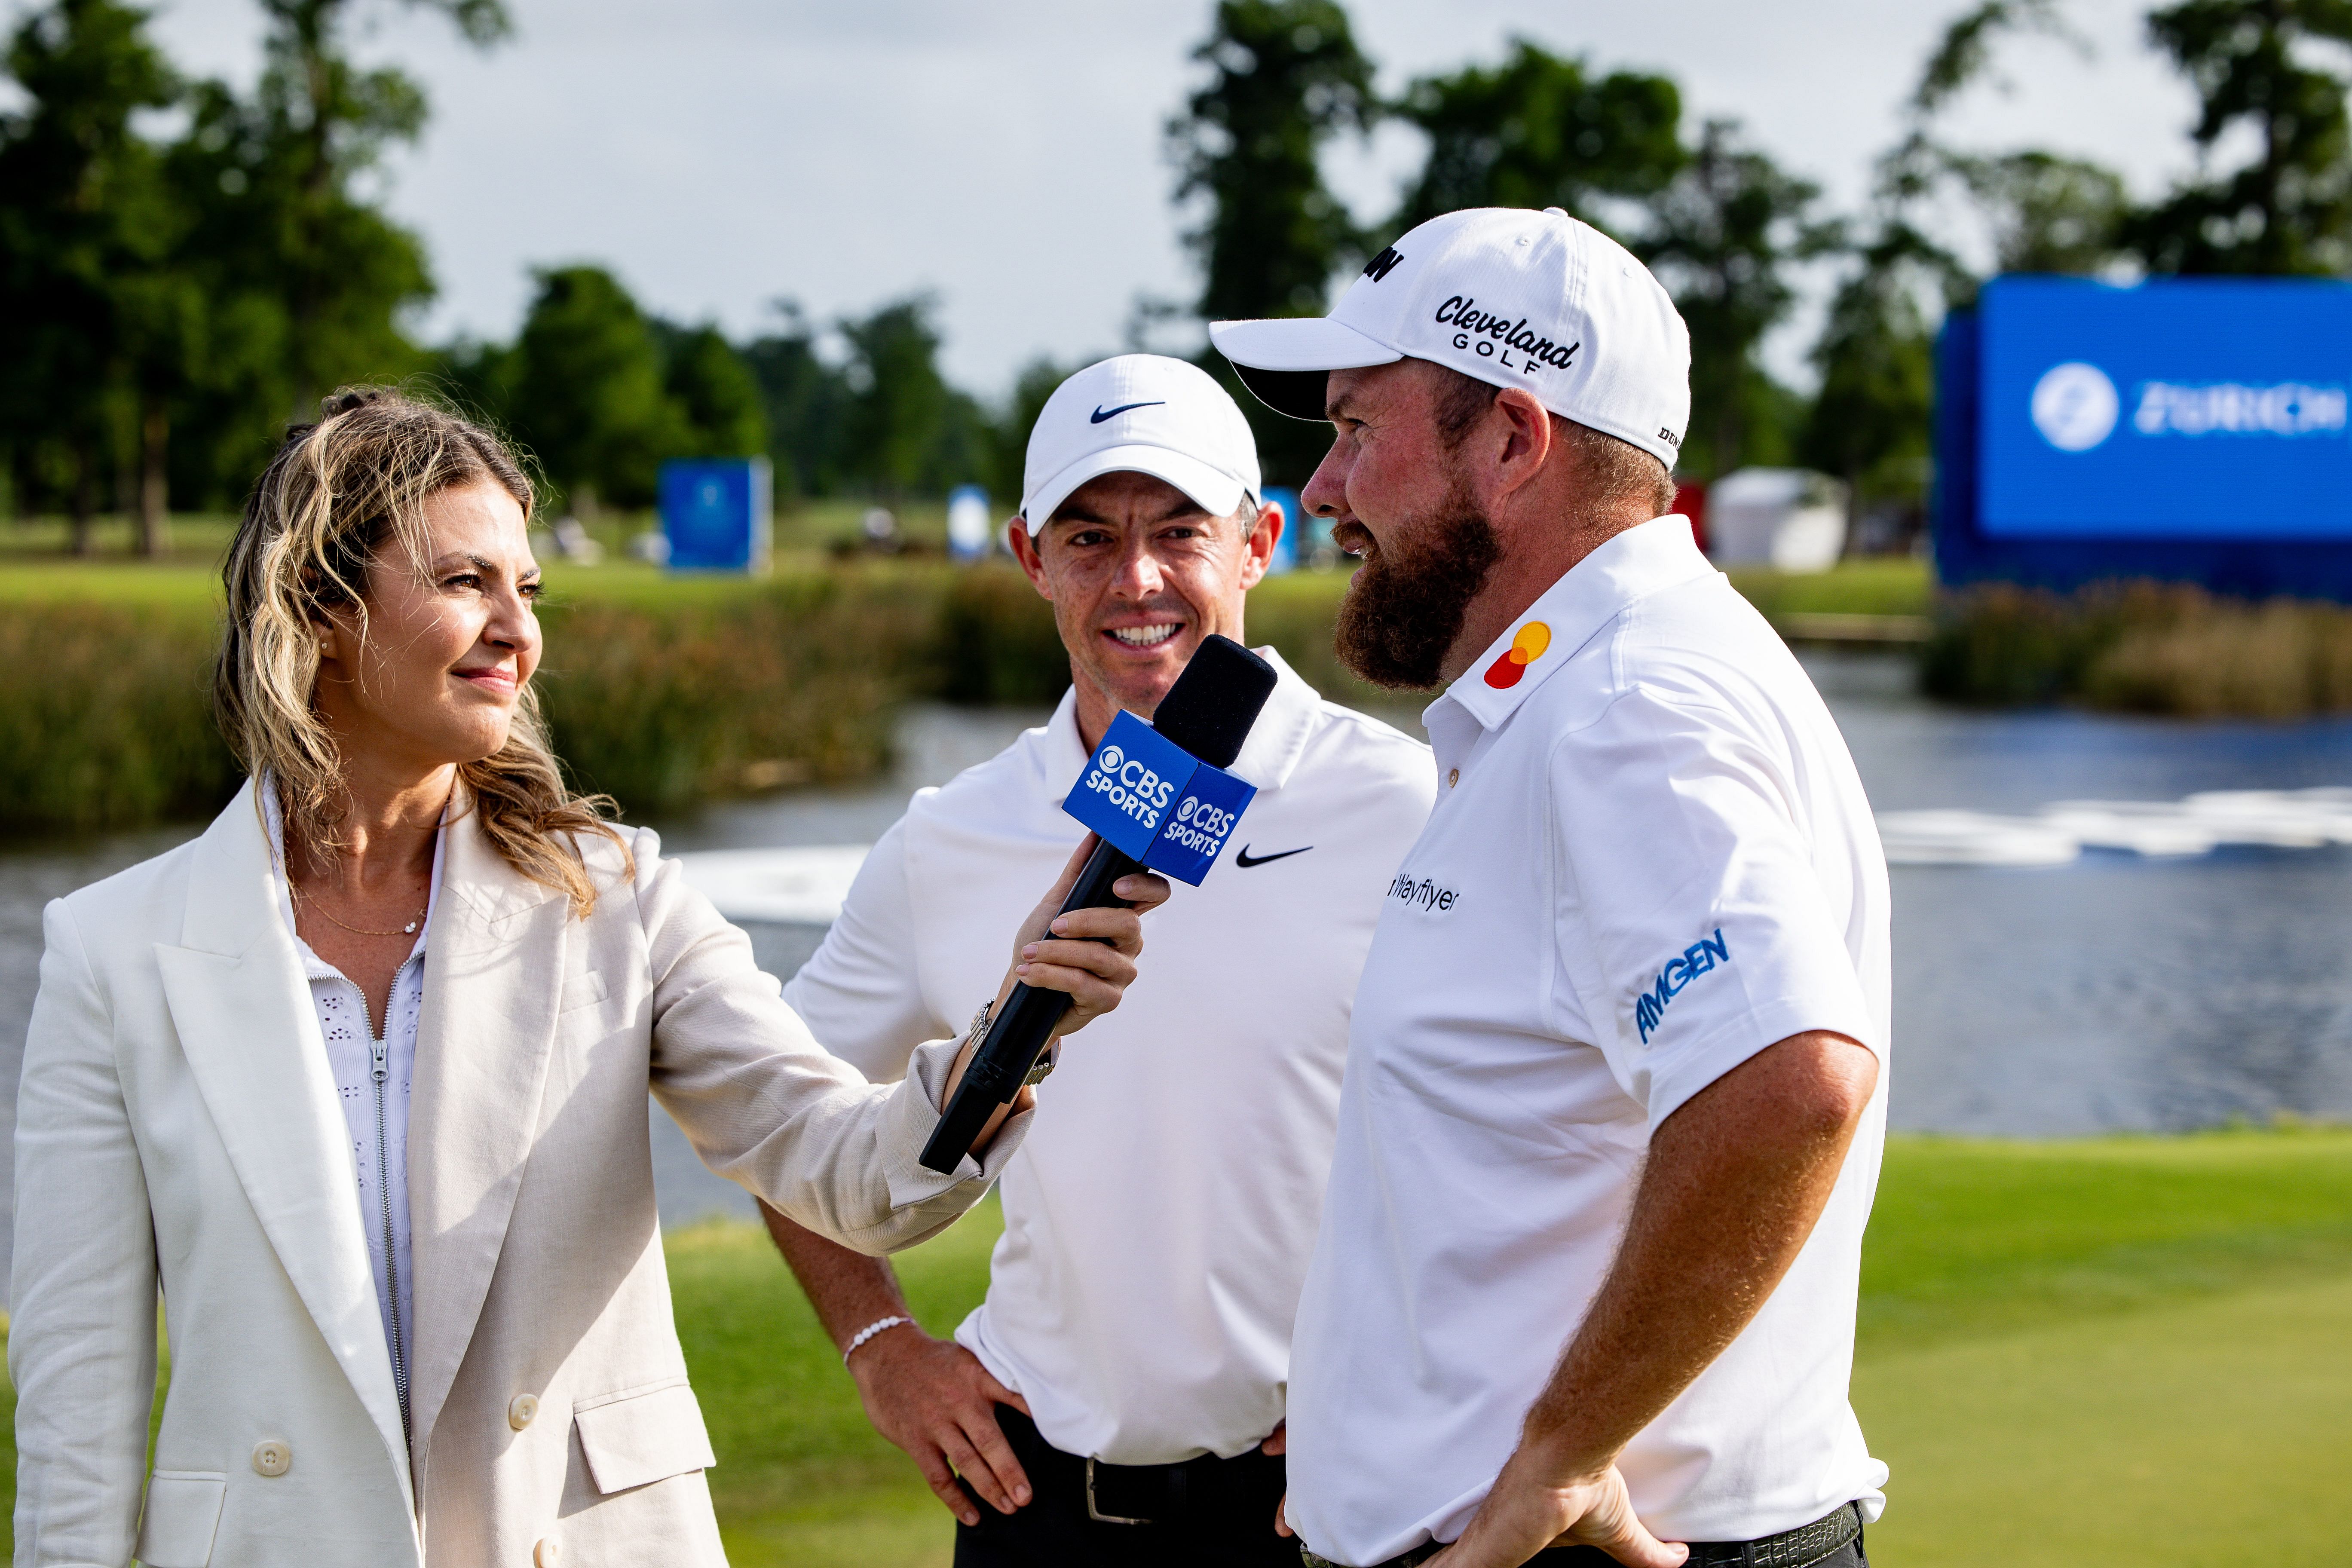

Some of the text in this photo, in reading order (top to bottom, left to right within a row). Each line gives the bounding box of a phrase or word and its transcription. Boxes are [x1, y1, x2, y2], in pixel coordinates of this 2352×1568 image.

[1435, 296, 1580, 370] Cleveland
[1453, 334, 1540, 374] GOLF
[2134, 382, 2347, 435] ZURICH
[1086, 770, 1160, 829] SPORTS
[1120, 760, 1174, 808] CBS
[1164, 822, 1220, 857] SPORTS
[1193, 803, 1234, 837] CBS
[1392, 874, 1459, 912] Wayflyer
[1636, 928, 1730, 1045] AMGEN
